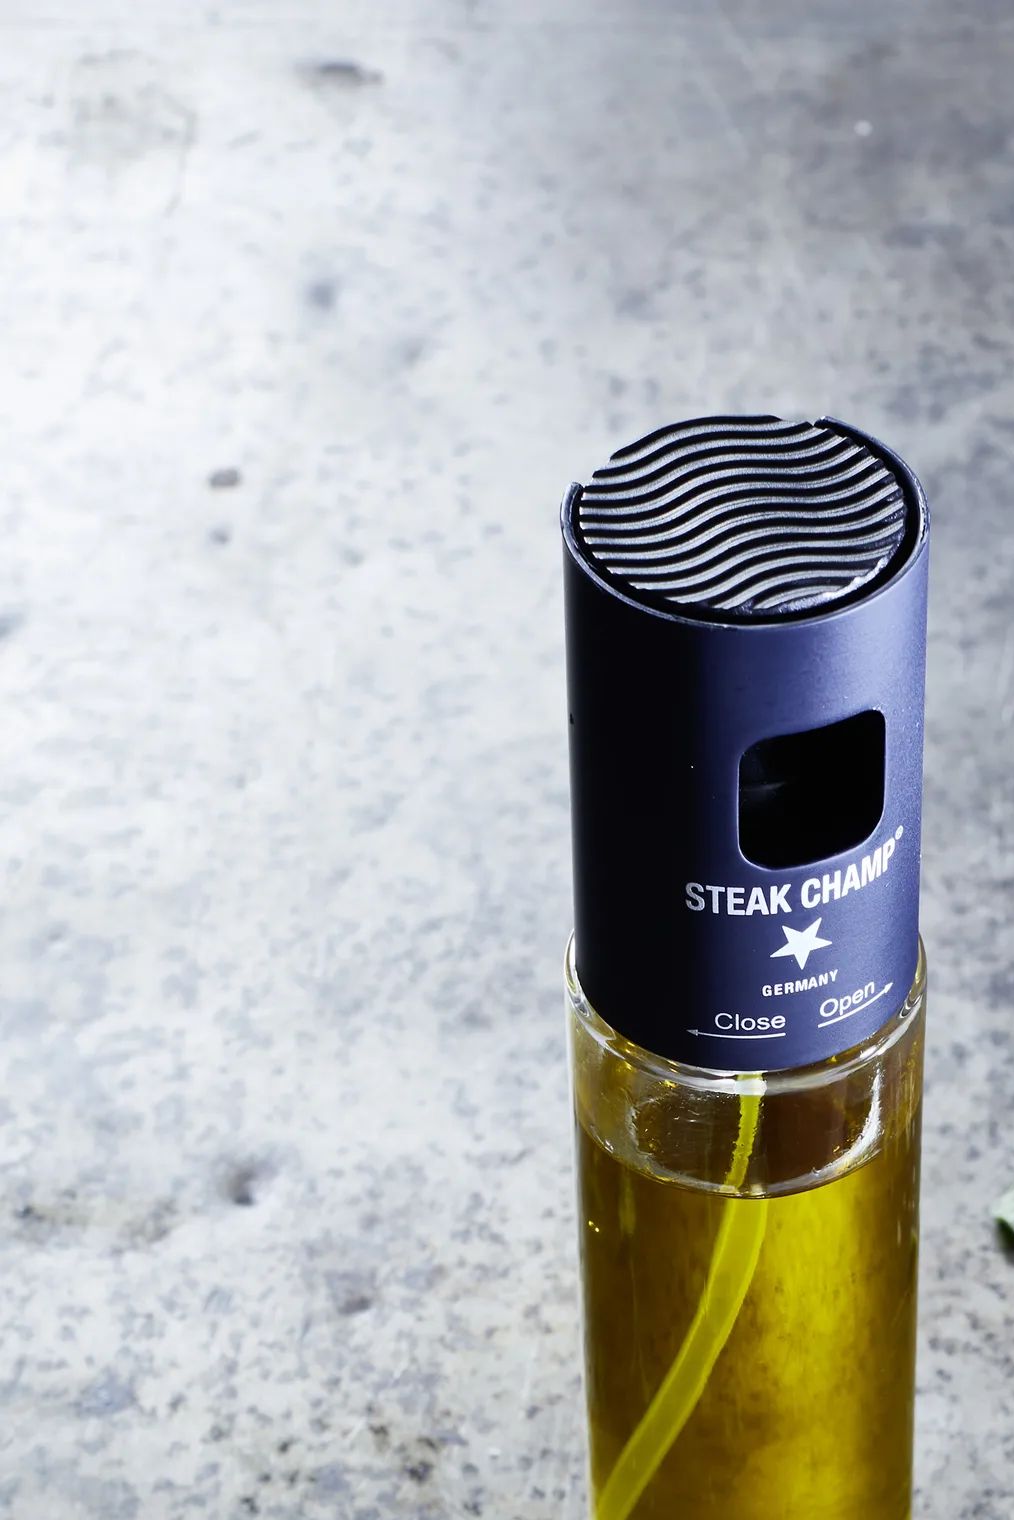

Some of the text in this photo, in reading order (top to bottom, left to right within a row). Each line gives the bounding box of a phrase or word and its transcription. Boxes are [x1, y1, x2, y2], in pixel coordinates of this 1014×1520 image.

[685, 882, 792, 916] STEAK
[762, 969, 838, 997] GERMANY
[819, 981, 875, 1018] Open
[714, 1012, 786, 1031] Close
